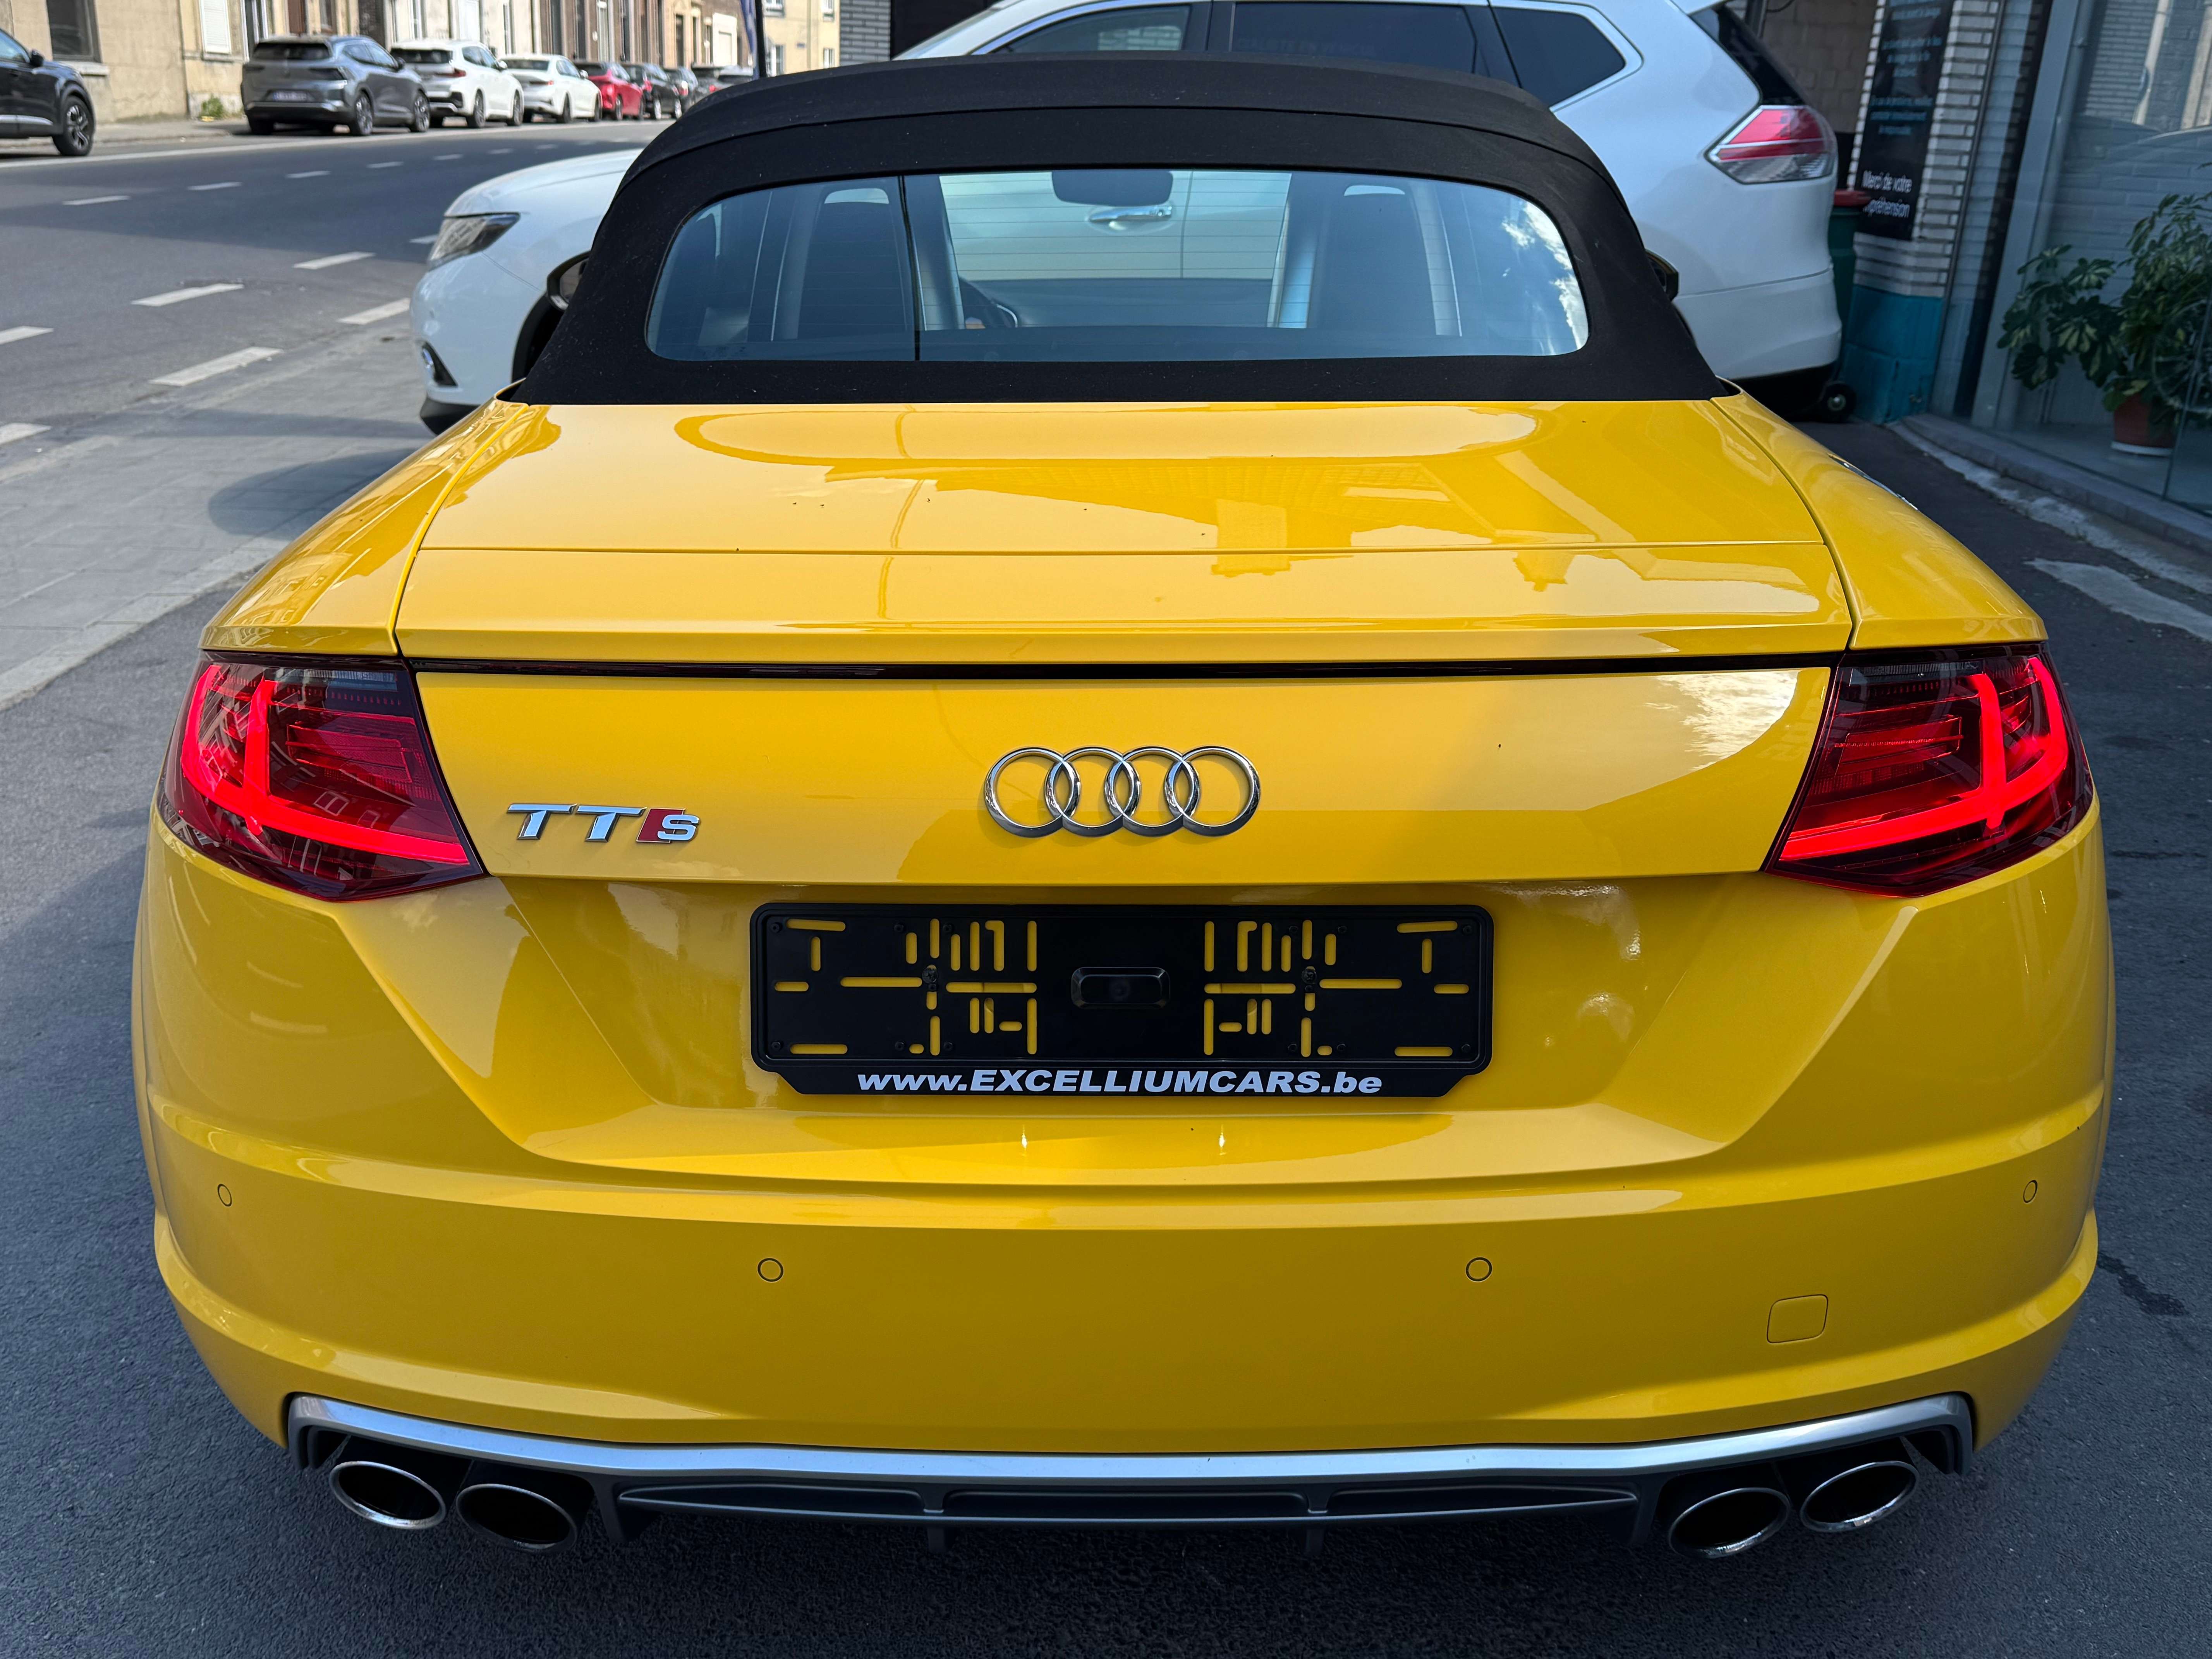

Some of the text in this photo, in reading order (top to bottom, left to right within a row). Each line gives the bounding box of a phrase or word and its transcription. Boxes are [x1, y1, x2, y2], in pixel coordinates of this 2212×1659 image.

[1882, 172, 1893, 191] de
[1893, 175, 1912, 193] votre
[507, 802, 701, 843] TTS
[857, 1069, 1382, 1093] www.EXCELLIUMCARS.be
